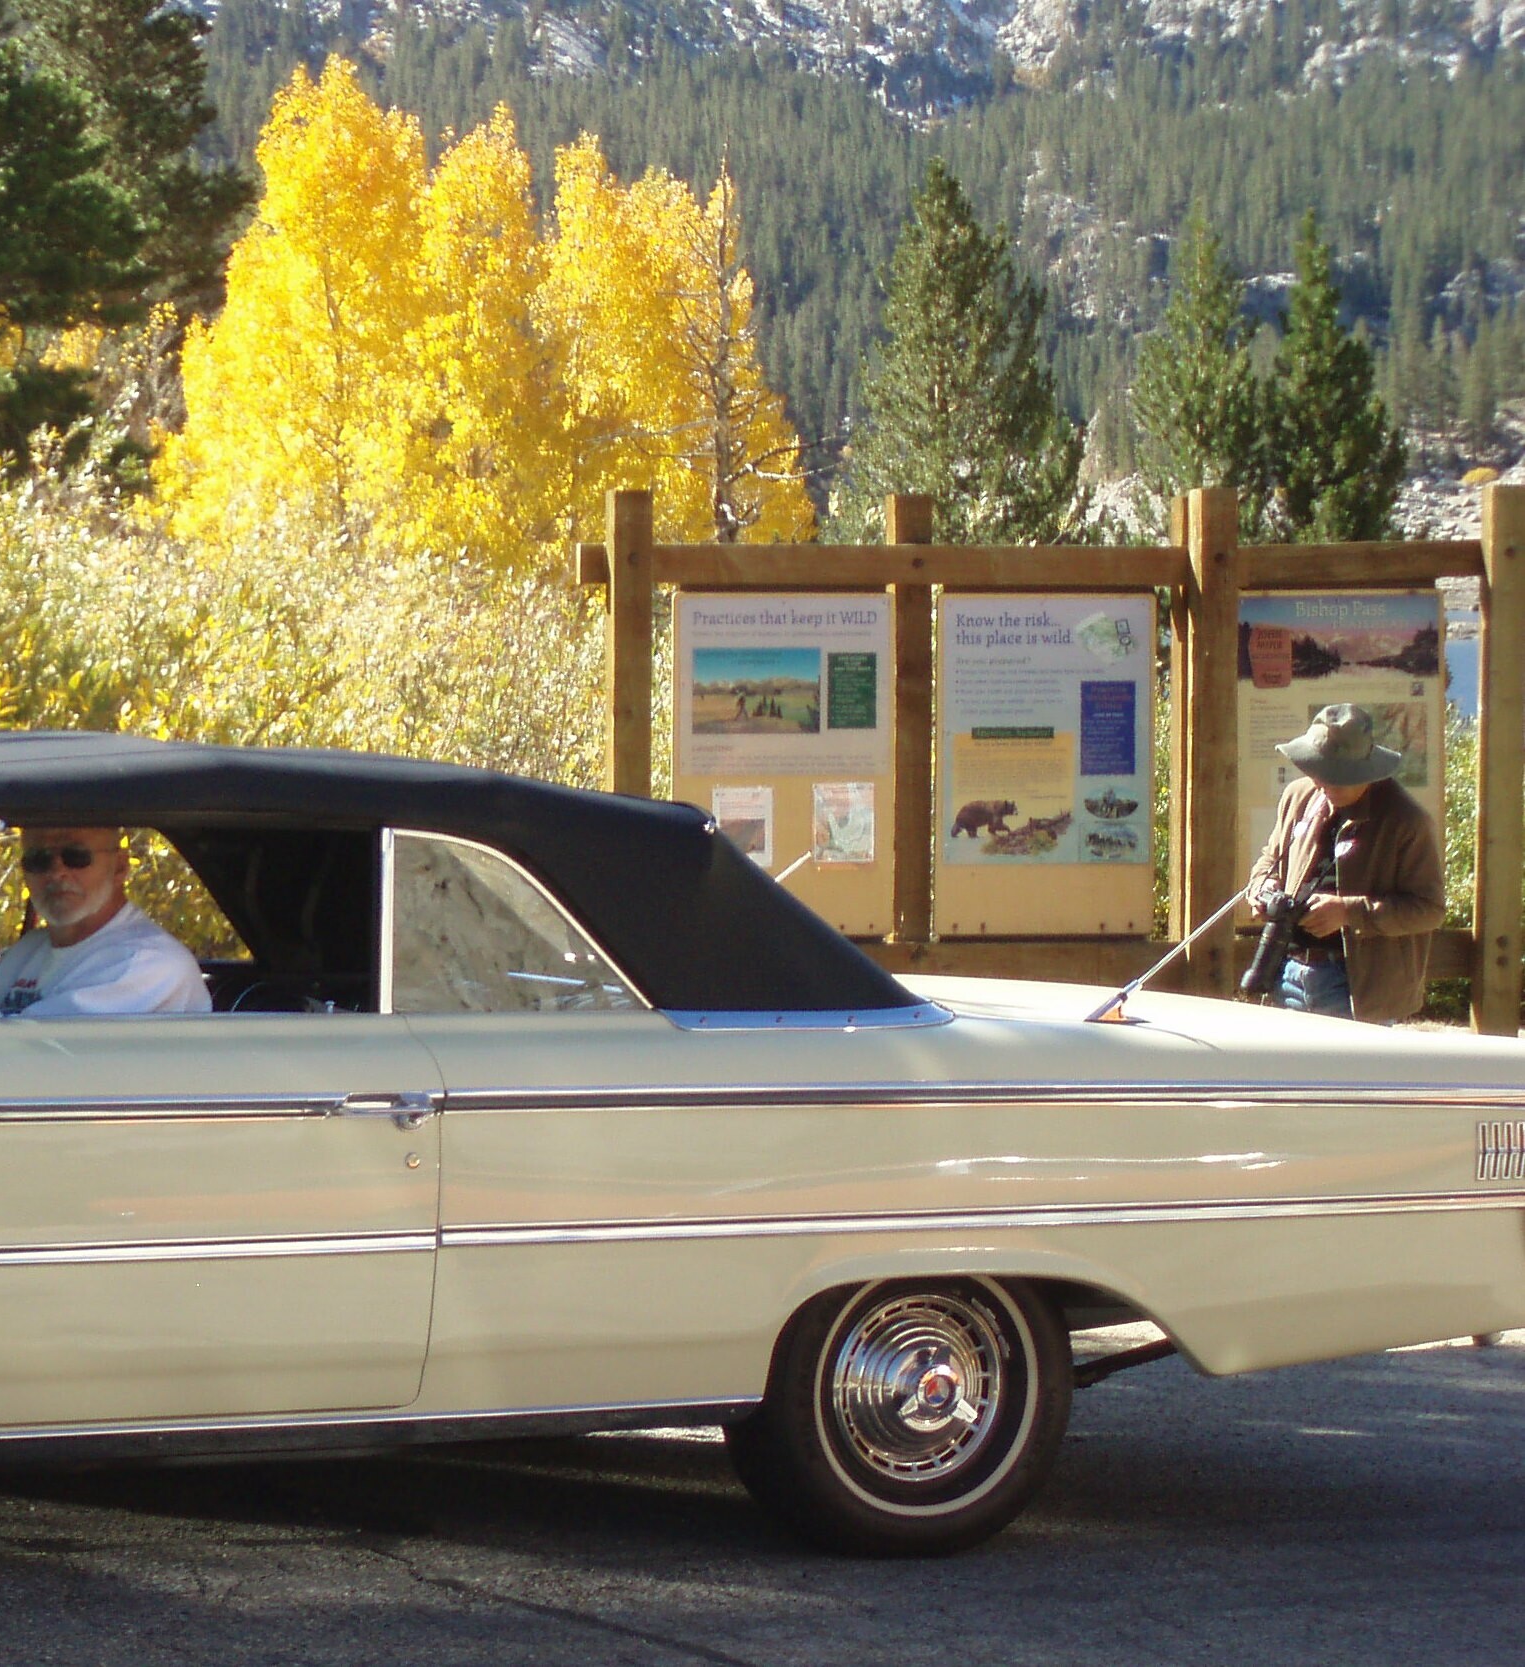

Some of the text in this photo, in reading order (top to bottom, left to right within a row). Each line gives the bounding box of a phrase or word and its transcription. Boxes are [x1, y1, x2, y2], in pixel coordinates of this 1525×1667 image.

[692, 609, 877, 628] Practices that keep it WILD
[955, 611, 1061, 627] Know the risk...
[1295, 600, 1386, 620] Bishop Pass
[955, 629, 1074, 648] this place is wild.
